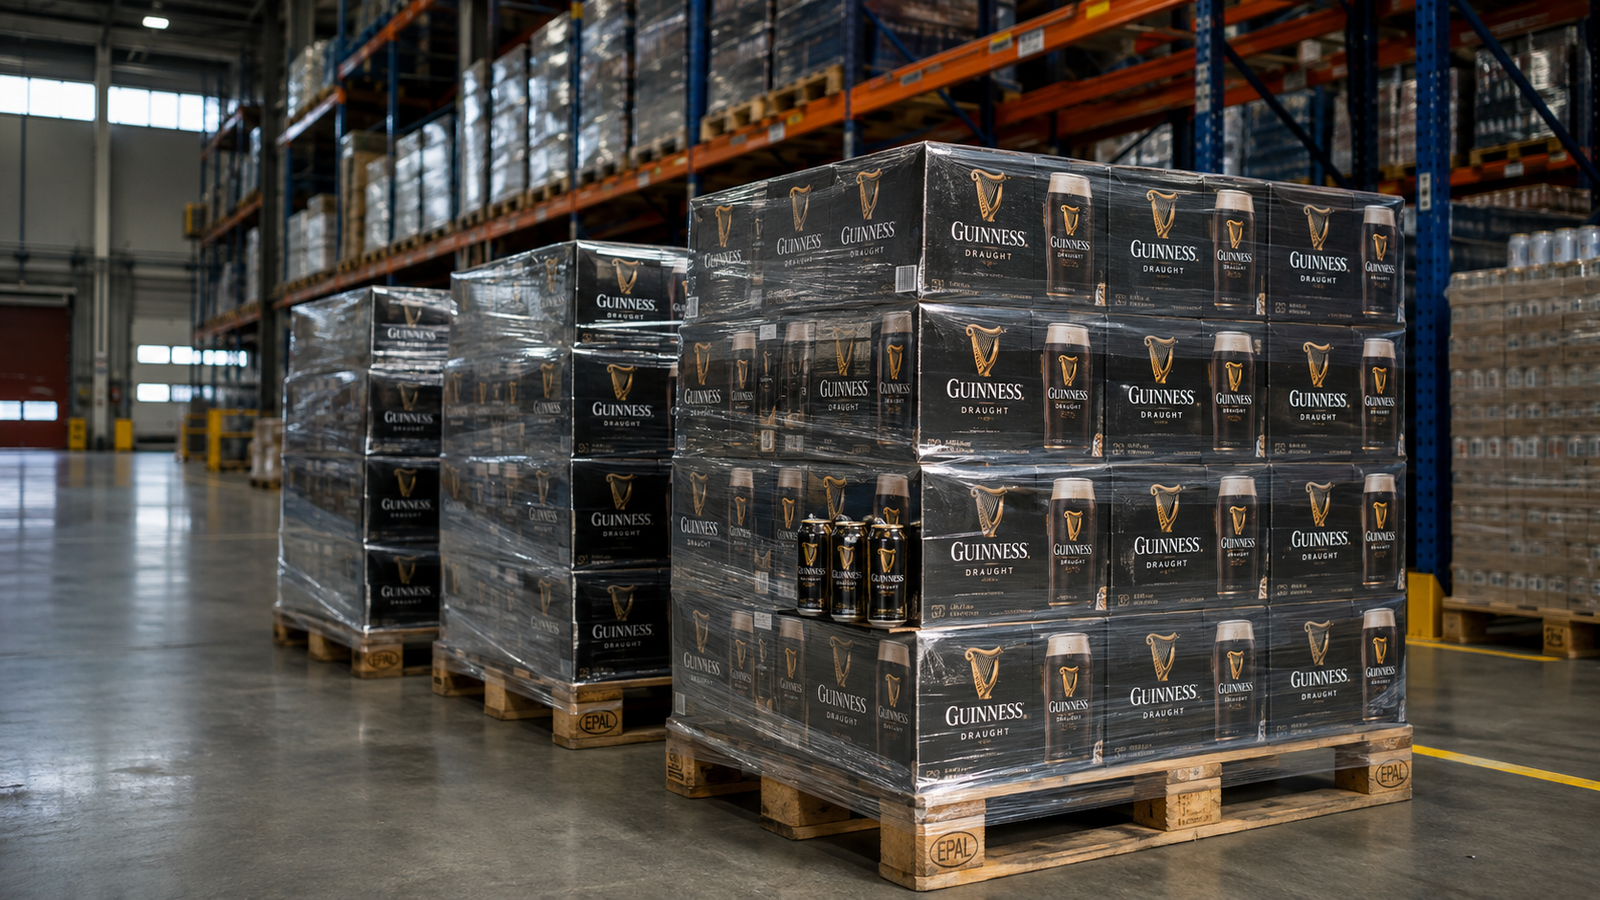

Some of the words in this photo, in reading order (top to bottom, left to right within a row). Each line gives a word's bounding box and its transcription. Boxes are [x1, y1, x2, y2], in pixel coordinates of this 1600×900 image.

[840, 220, 896, 246] GUINNESS
[951, 221, 1026, 247] GUINNESS
[776, 233, 822, 256] GUINNESS
[1050, 235, 1091, 251] GUINNESS
[1130, 239, 1197, 261] GUINNESS
[849, 246, 885, 258] DRAUGHT
[965, 249, 1012, 260] DRAUGHT
[1143, 265, 1184, 274] DRAUGHT
[1289, 251, 1348, 272] GUINNESS
[1300, 275, 1337, 284] DRAUGHT
[596, 293, 656, 311] GUINNESS
[387, 327, 437, 341] GUINNESS
[819, 379, 870, 398] GUINNESS
[946, 378, 1023, 401] GUINNESS
[1047, 386, 1089, 401] GUINNESS
[1128, 385, 1195, 406] GUINNESS
[1289, 389, 1347, 408] GUINNESS
[592, 401, 653, 417] GUINNESS
[961, 406, 1009, 415] DRAUGHT
[1141, 410, 1183, 419] DRAUGHT
[1300, 413, 1337, 421] DRAUGHT
[384, 410, 434, 425] GUINNESS
[381, 498, 432, 511] GUINNESS
[591, 511, 652, 527] GUINNESS
[680, 516, 719, 537] GUINNESS
[603, 530, 641, 538] DRAUGHT
[1291, 530, 1349, 549] GUINNESS
[950, 541, 1029, 562] GUINNESS
[1053, 542, 1093, 556] GUINNESS
[1134, 536, 1201, 556] GUINNESS
[1146, 559, 1188, 569] DRAUGHT
[1301, 552, 1339, 561] DRAUGHT
[965, 566, 1014, 577] DRAUGHT
[381, 585, 432, 598] GUINNESS
[592, 623, 653, 640] GUINNESS
[1290, 668, 1349, 689] GUINNESS
[817, 684, 867, 714] GUINNESS
[1130, 683, 1198, 706] GUINNESS
[1301, 690, 1338, 701] DRAUGHT
[945, 702, 1024, 727] GUINNESS
[1048, 699, 1089, 714] GUINNESS
[1142, 707, 1185, 720] DRAUGHT
[585, 714, 613, 730] EPAL
[826, 711, 858, 726] DRAUGHT
[960, 727, 1010, 741] DRAUGHT
[1381, 763, 1404, 783] EPAL
[937, 837, 972, 862] EPAL
